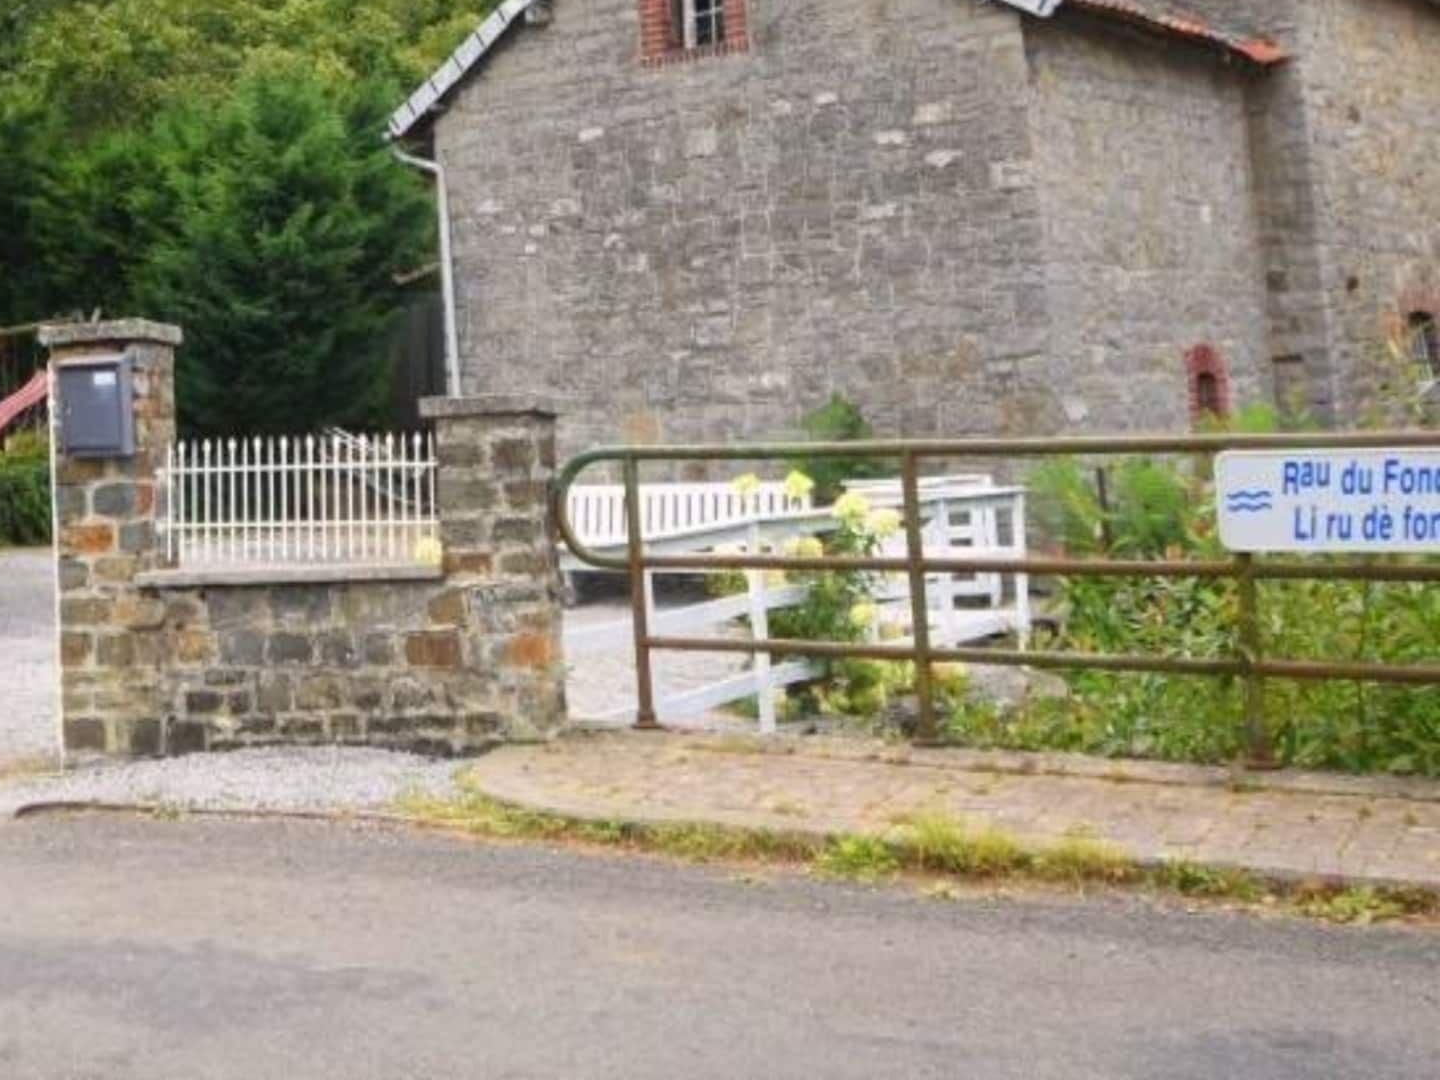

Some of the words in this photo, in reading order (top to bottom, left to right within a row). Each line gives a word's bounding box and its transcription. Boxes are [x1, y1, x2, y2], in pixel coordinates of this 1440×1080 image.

[1282, 461, 1331, 495] Rau
[1341, 460, 1373, 495] du
[1295, 506, 1317, 540] Li
[1327, 514, 1352, 540] ru
